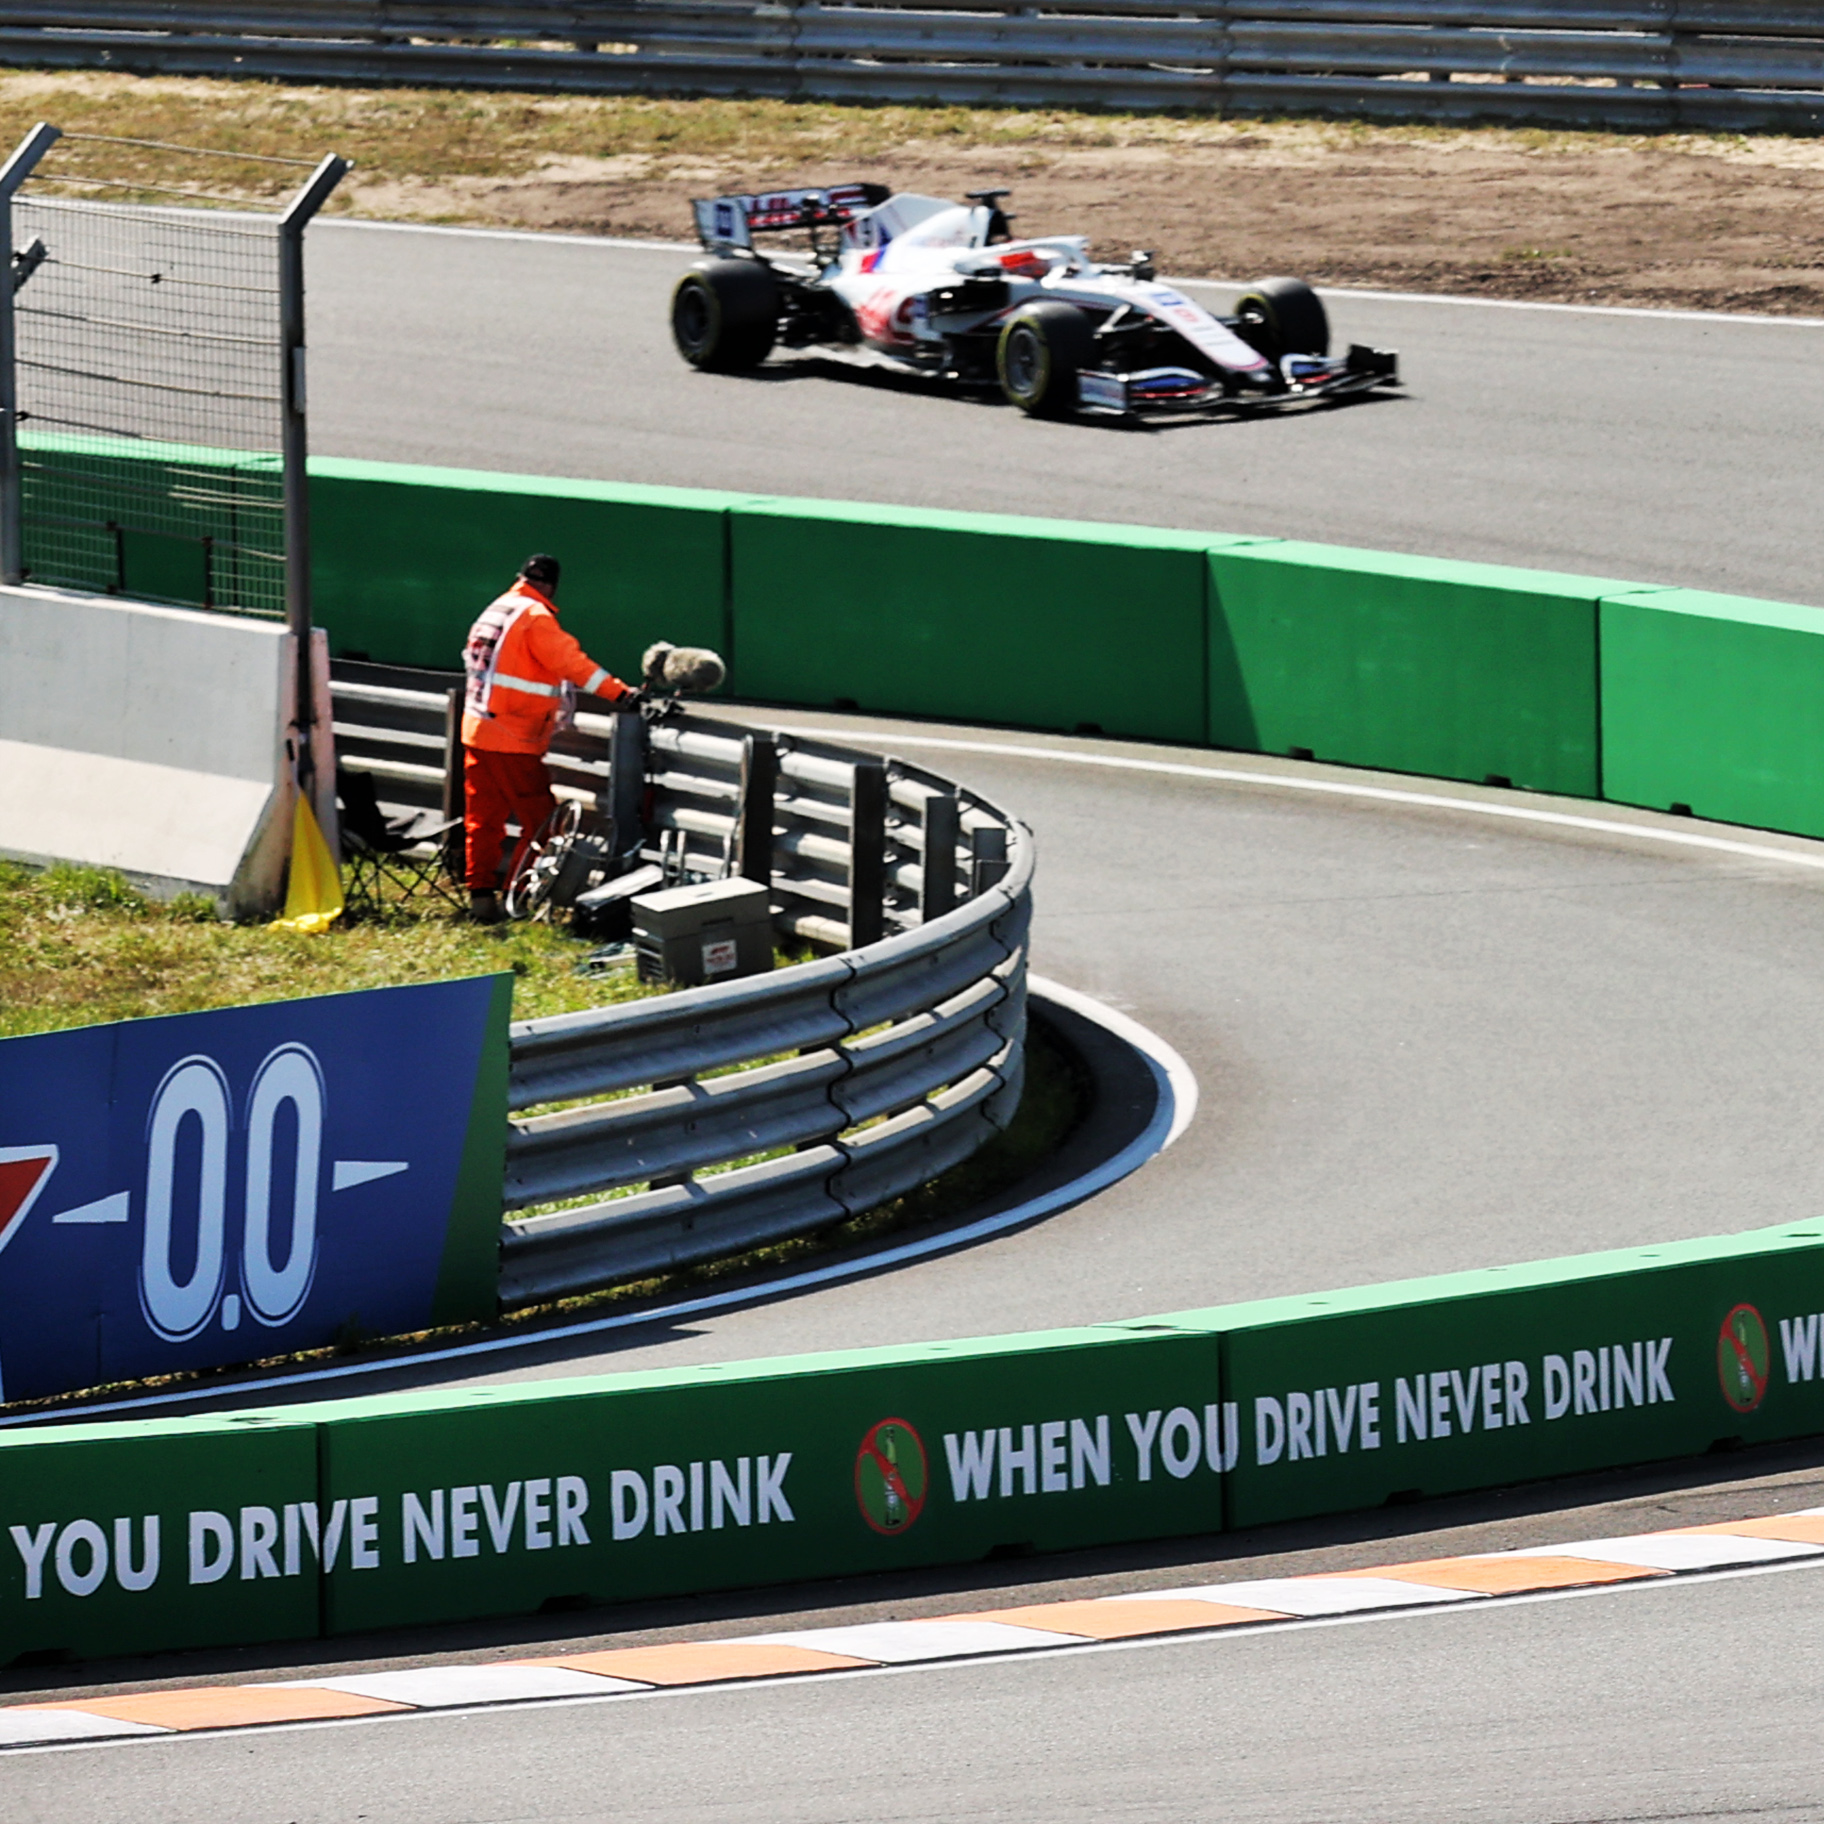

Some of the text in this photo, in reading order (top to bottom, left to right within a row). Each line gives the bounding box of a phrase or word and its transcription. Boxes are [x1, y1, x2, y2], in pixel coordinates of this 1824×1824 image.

[139, 1043, 327, 1342] 0.0
[943, 1337, 1675, 1503] WHEN YOU DRIVE NEVER DRINK
[8, 1452, 796, 1600] YOU DRIVE NEVER DRINK
